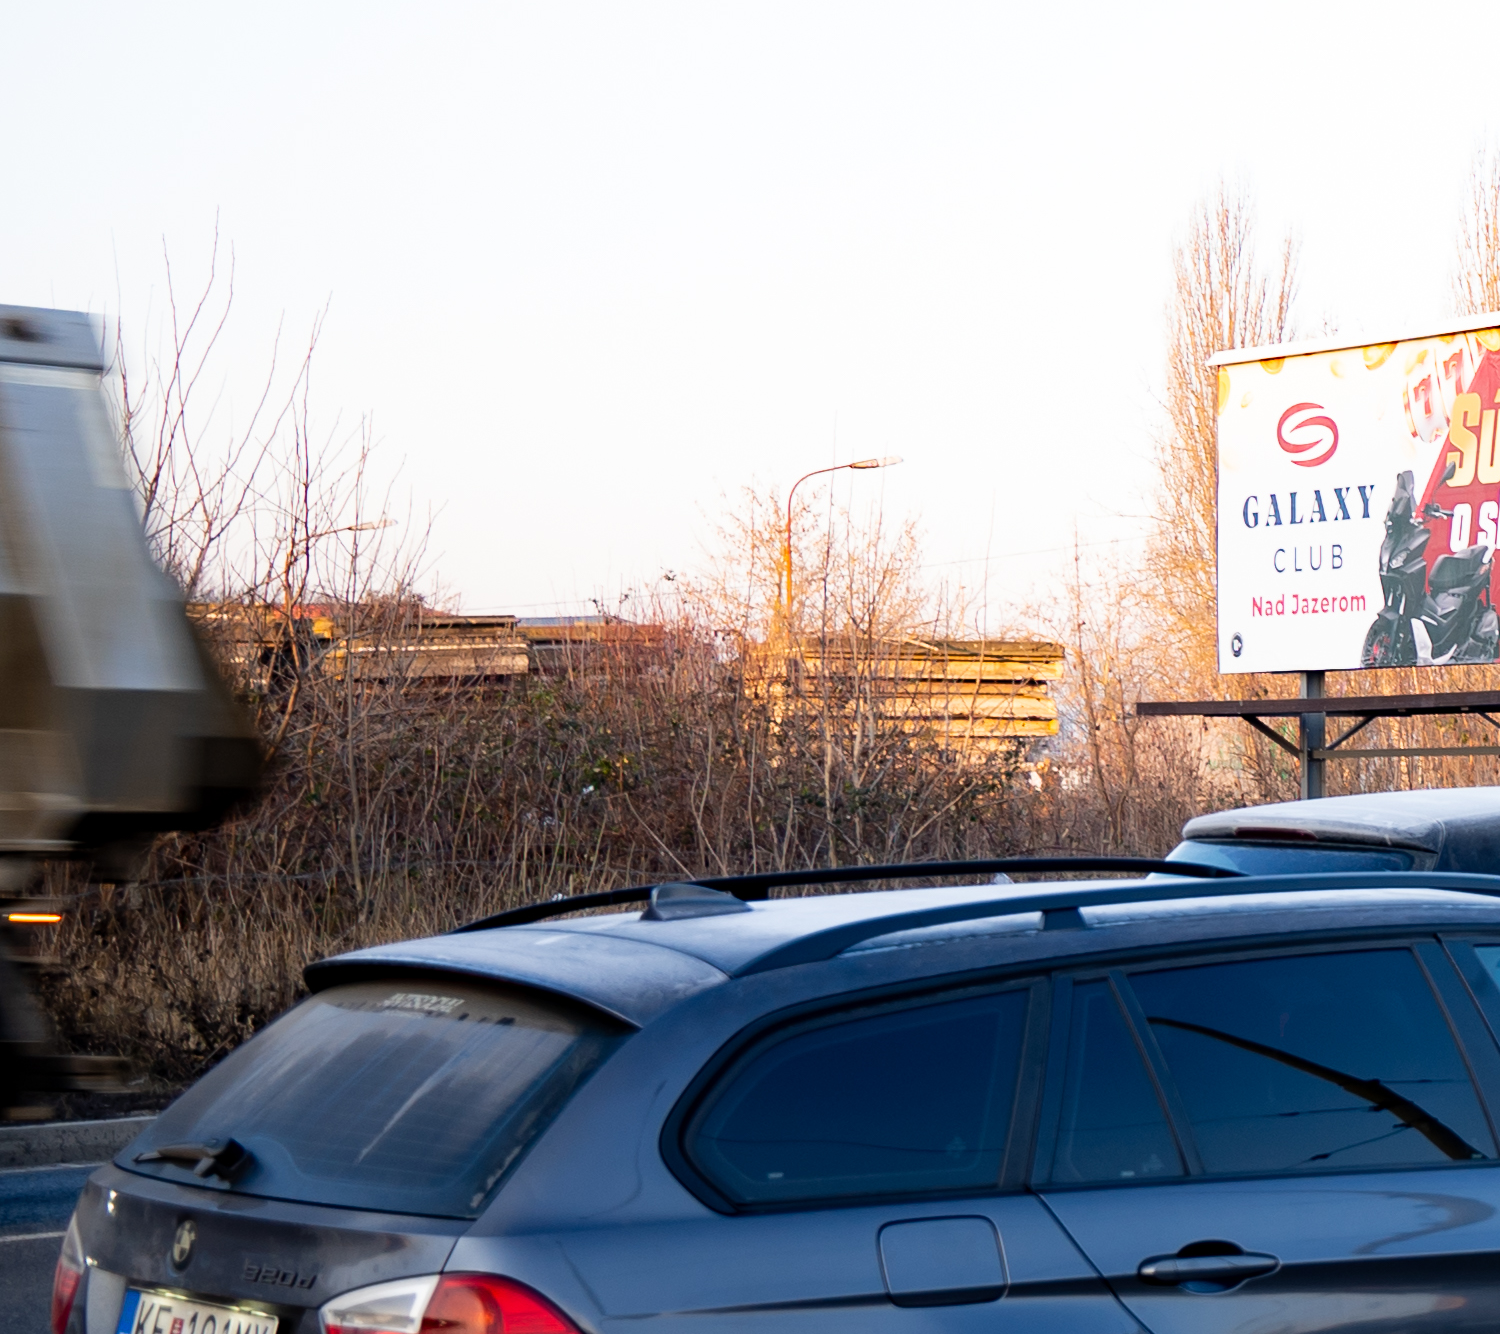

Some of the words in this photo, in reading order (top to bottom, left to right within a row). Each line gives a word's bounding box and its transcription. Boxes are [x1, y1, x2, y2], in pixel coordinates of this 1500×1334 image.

[1242, 484, 1375, 529] GALAXY
[1450, 503, 1473, 553] o
[1273, 543, 1344, 574] CLUB
[1252, 594, 1285, 618] Nad
[1291, 593, 1366, 615] Jazerom
